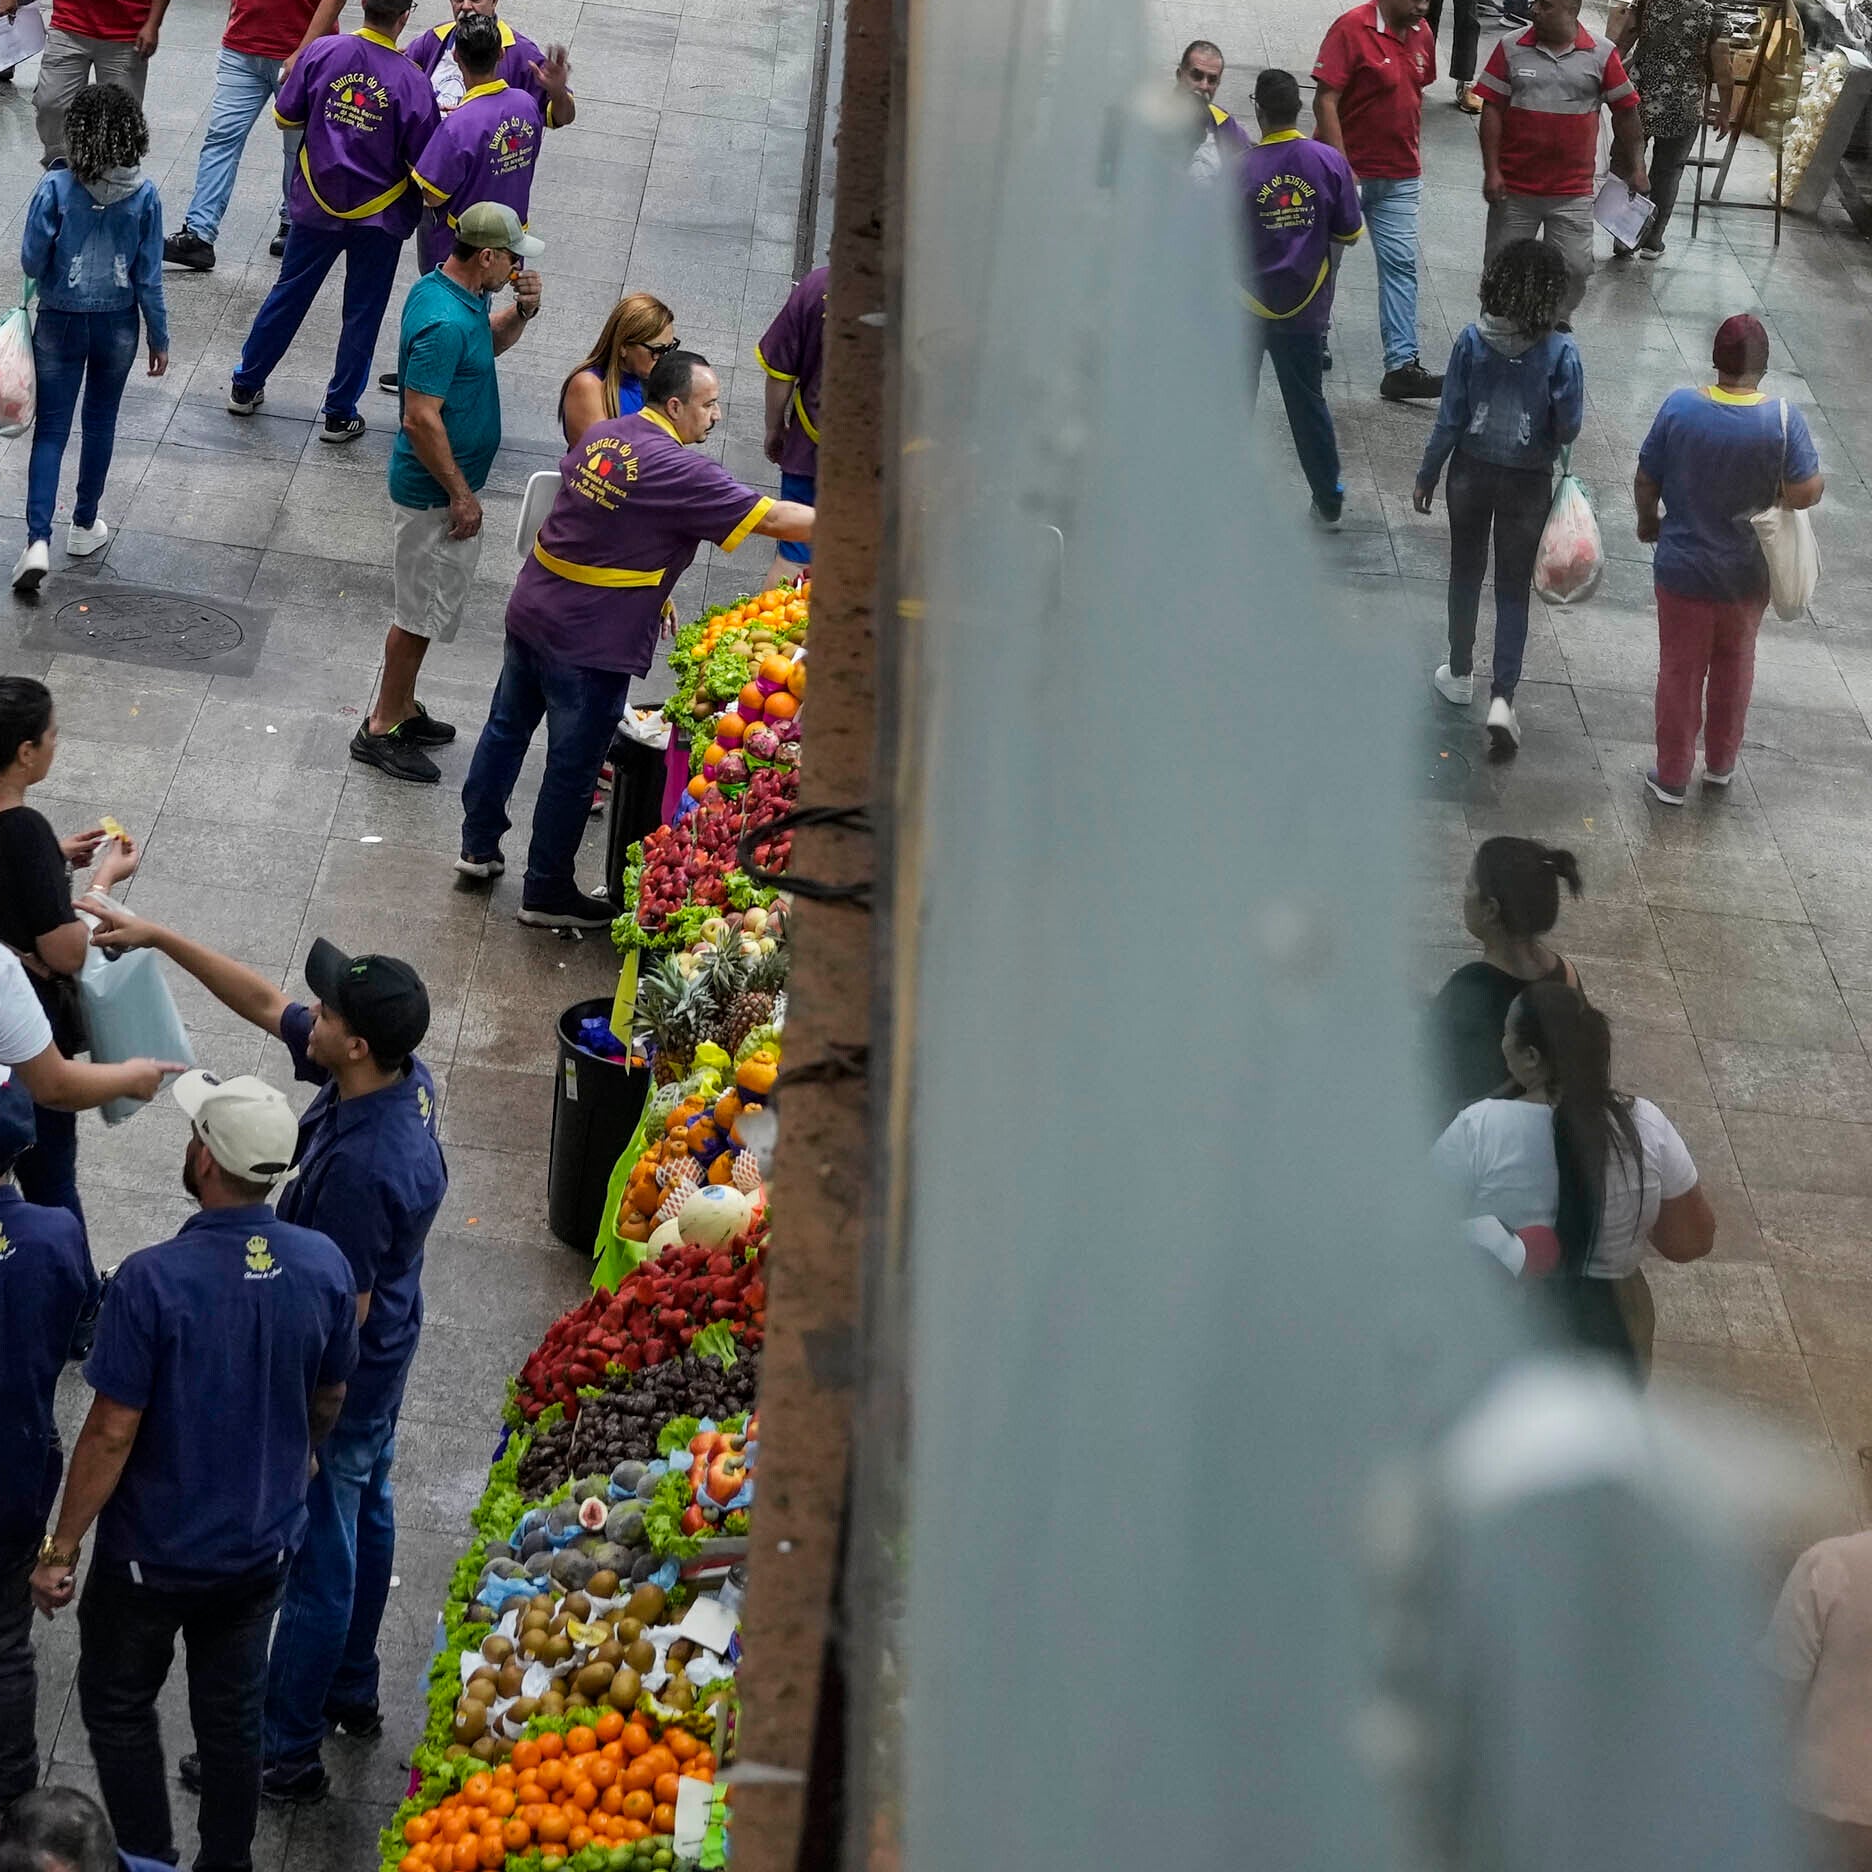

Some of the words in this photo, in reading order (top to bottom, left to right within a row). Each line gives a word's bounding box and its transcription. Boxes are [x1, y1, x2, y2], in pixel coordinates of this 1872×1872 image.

[330, 73, 364, 92] Barraca
[366, 76, 378, 89] do
[373, 87, 388, 109] Juca
[586, 437, 620, 456] Barraca
[619, 443, 632, 457] do
[623, 456, 639, 481] Juca
